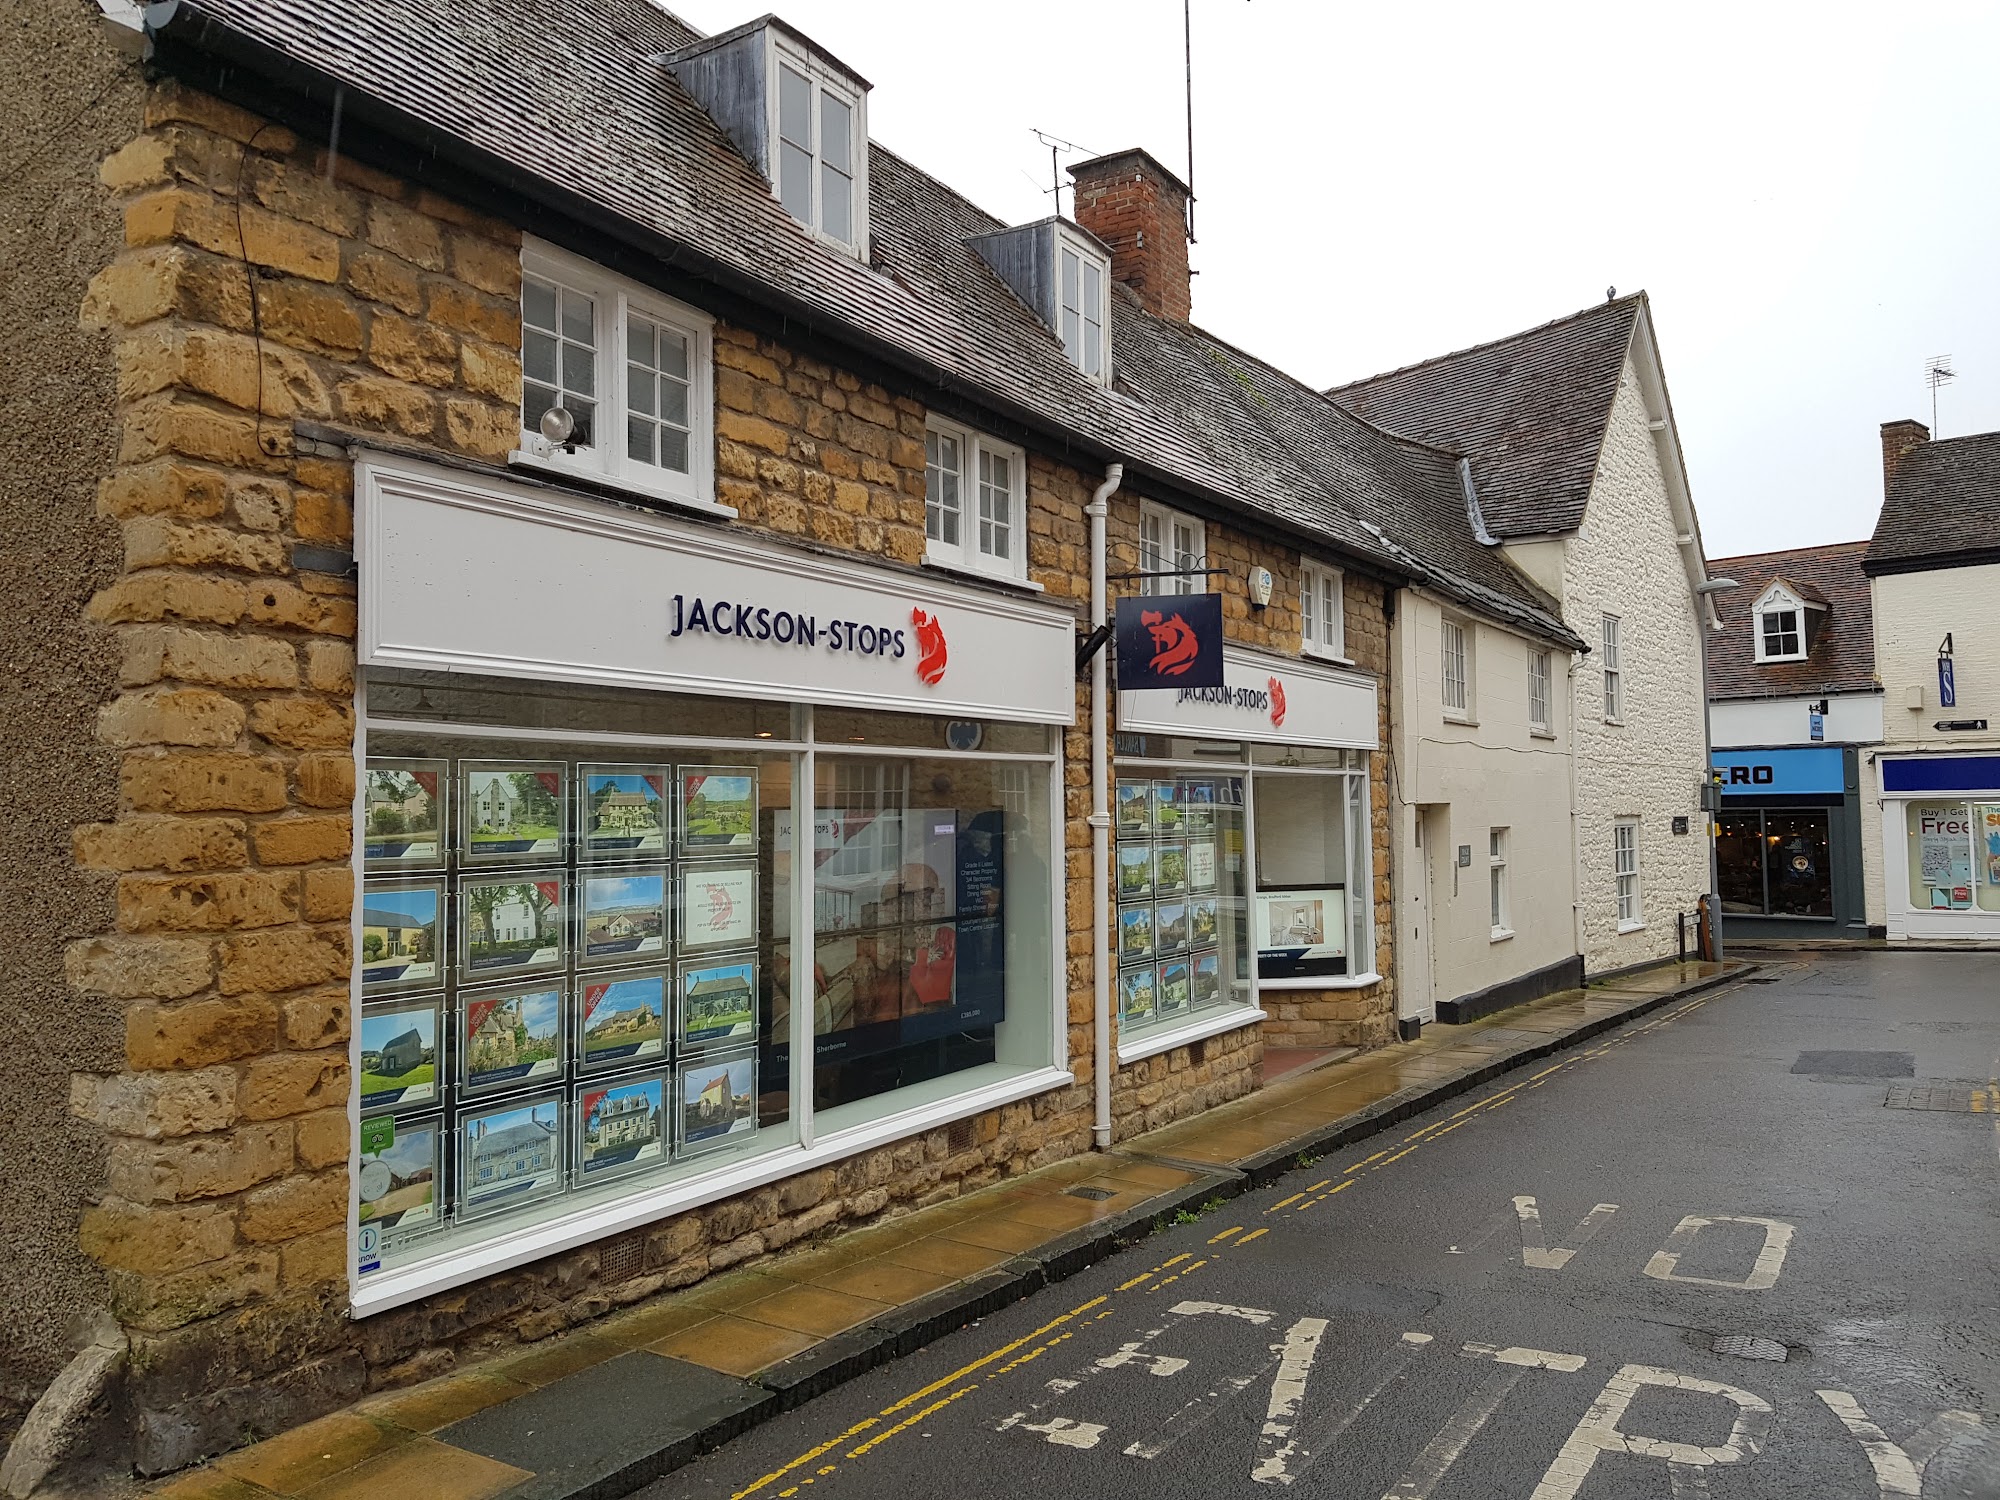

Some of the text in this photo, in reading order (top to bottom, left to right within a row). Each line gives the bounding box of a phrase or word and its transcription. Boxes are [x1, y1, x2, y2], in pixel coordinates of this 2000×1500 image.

[669, 594, 905, 658] JACKSON-STOPS
[1943, 671, 1953, 704] S
[1920, 808, 1940, 817] Buy
[1950, 808, 1968, 816] Get
[1921, 817, 1976, 834] Free
[776, 1041, 847, 1063] The Sherborne
[363, 1119, 392, 1131] REVIEWED
